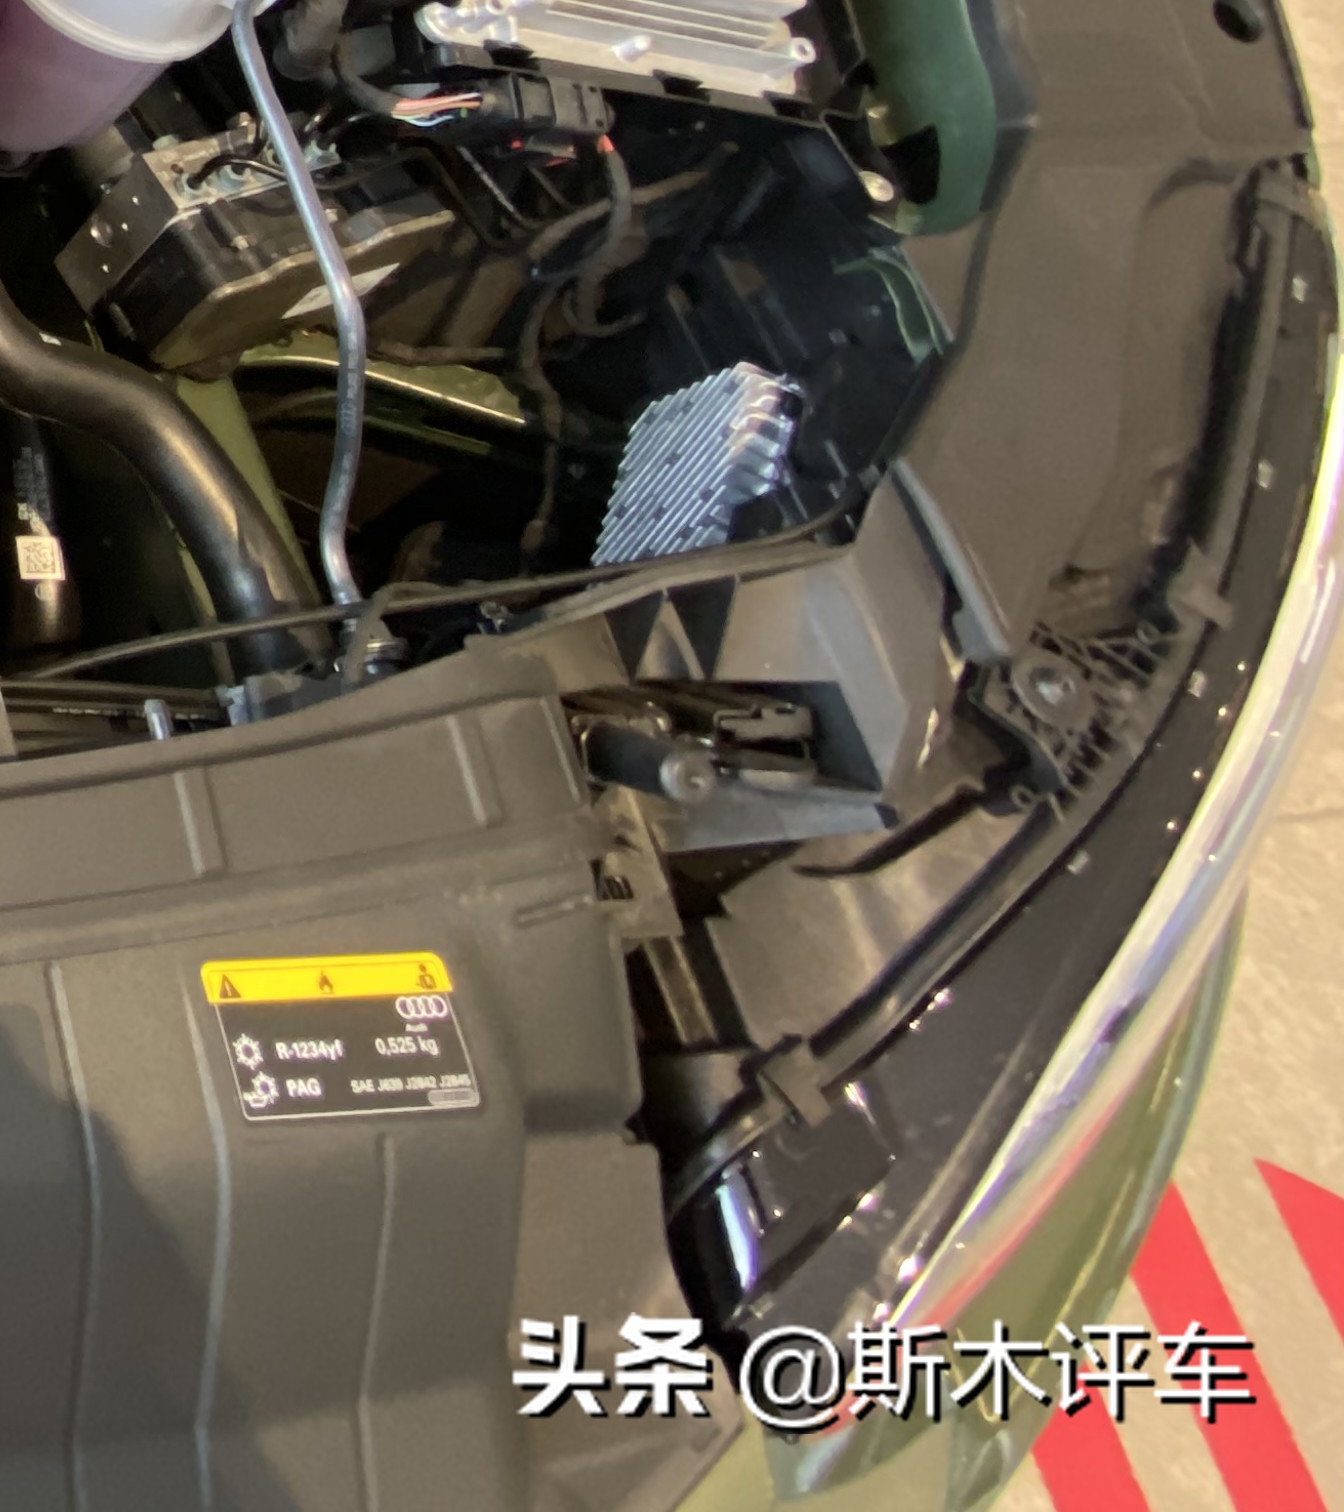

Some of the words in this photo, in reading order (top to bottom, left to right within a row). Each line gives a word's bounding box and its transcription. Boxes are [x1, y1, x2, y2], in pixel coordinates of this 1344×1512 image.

[275, 1039, 344, 1061] R-1234yf
[374, 1036, 417, 1056] 0,525
[417, 1035, 440, 1056] kg
[285, 1078, 322, 1098] PAG
[350, 1079, 375, 1094] SAE
